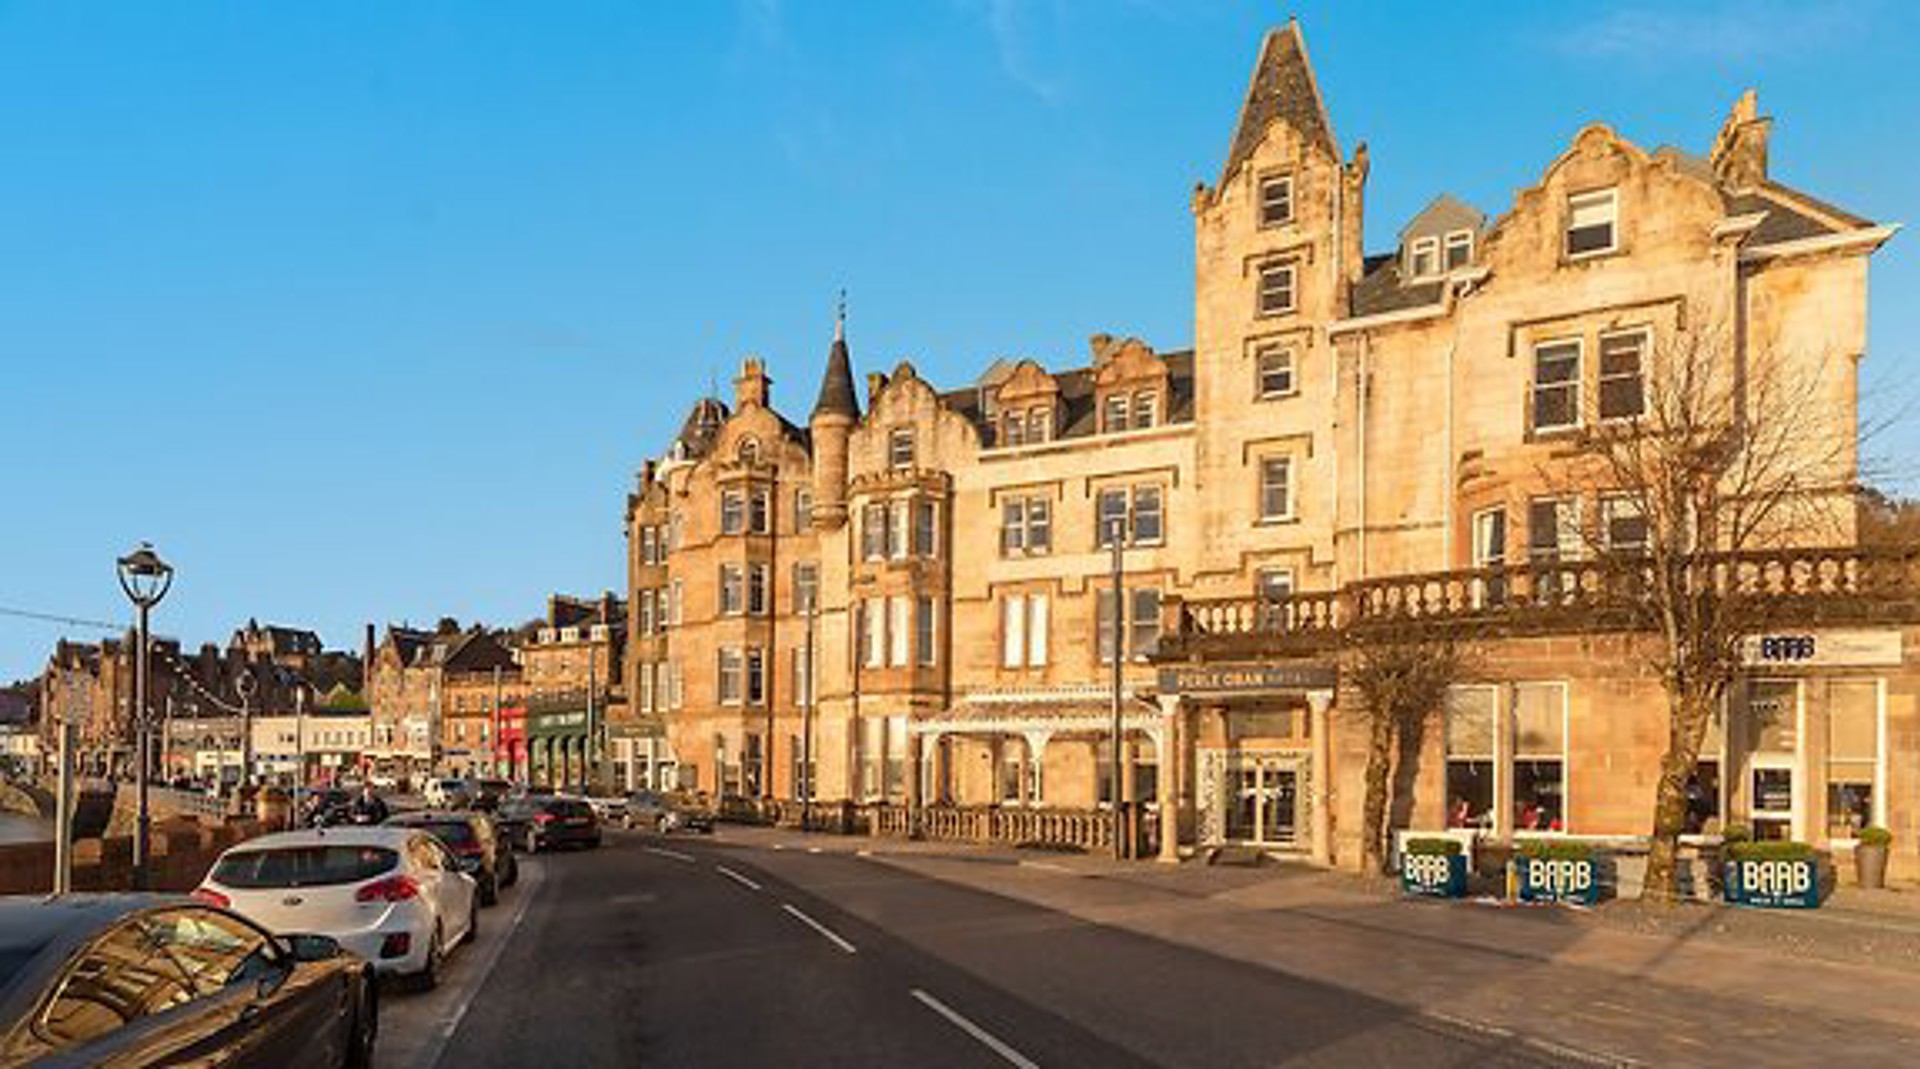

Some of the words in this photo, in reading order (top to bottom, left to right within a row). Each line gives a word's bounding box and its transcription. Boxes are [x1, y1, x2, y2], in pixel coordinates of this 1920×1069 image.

[1405, 854, 1450, 886] BAAB
[1529, 860, 1591, 892] BAAB
[1743, 861, 1811, 894] BAAB
